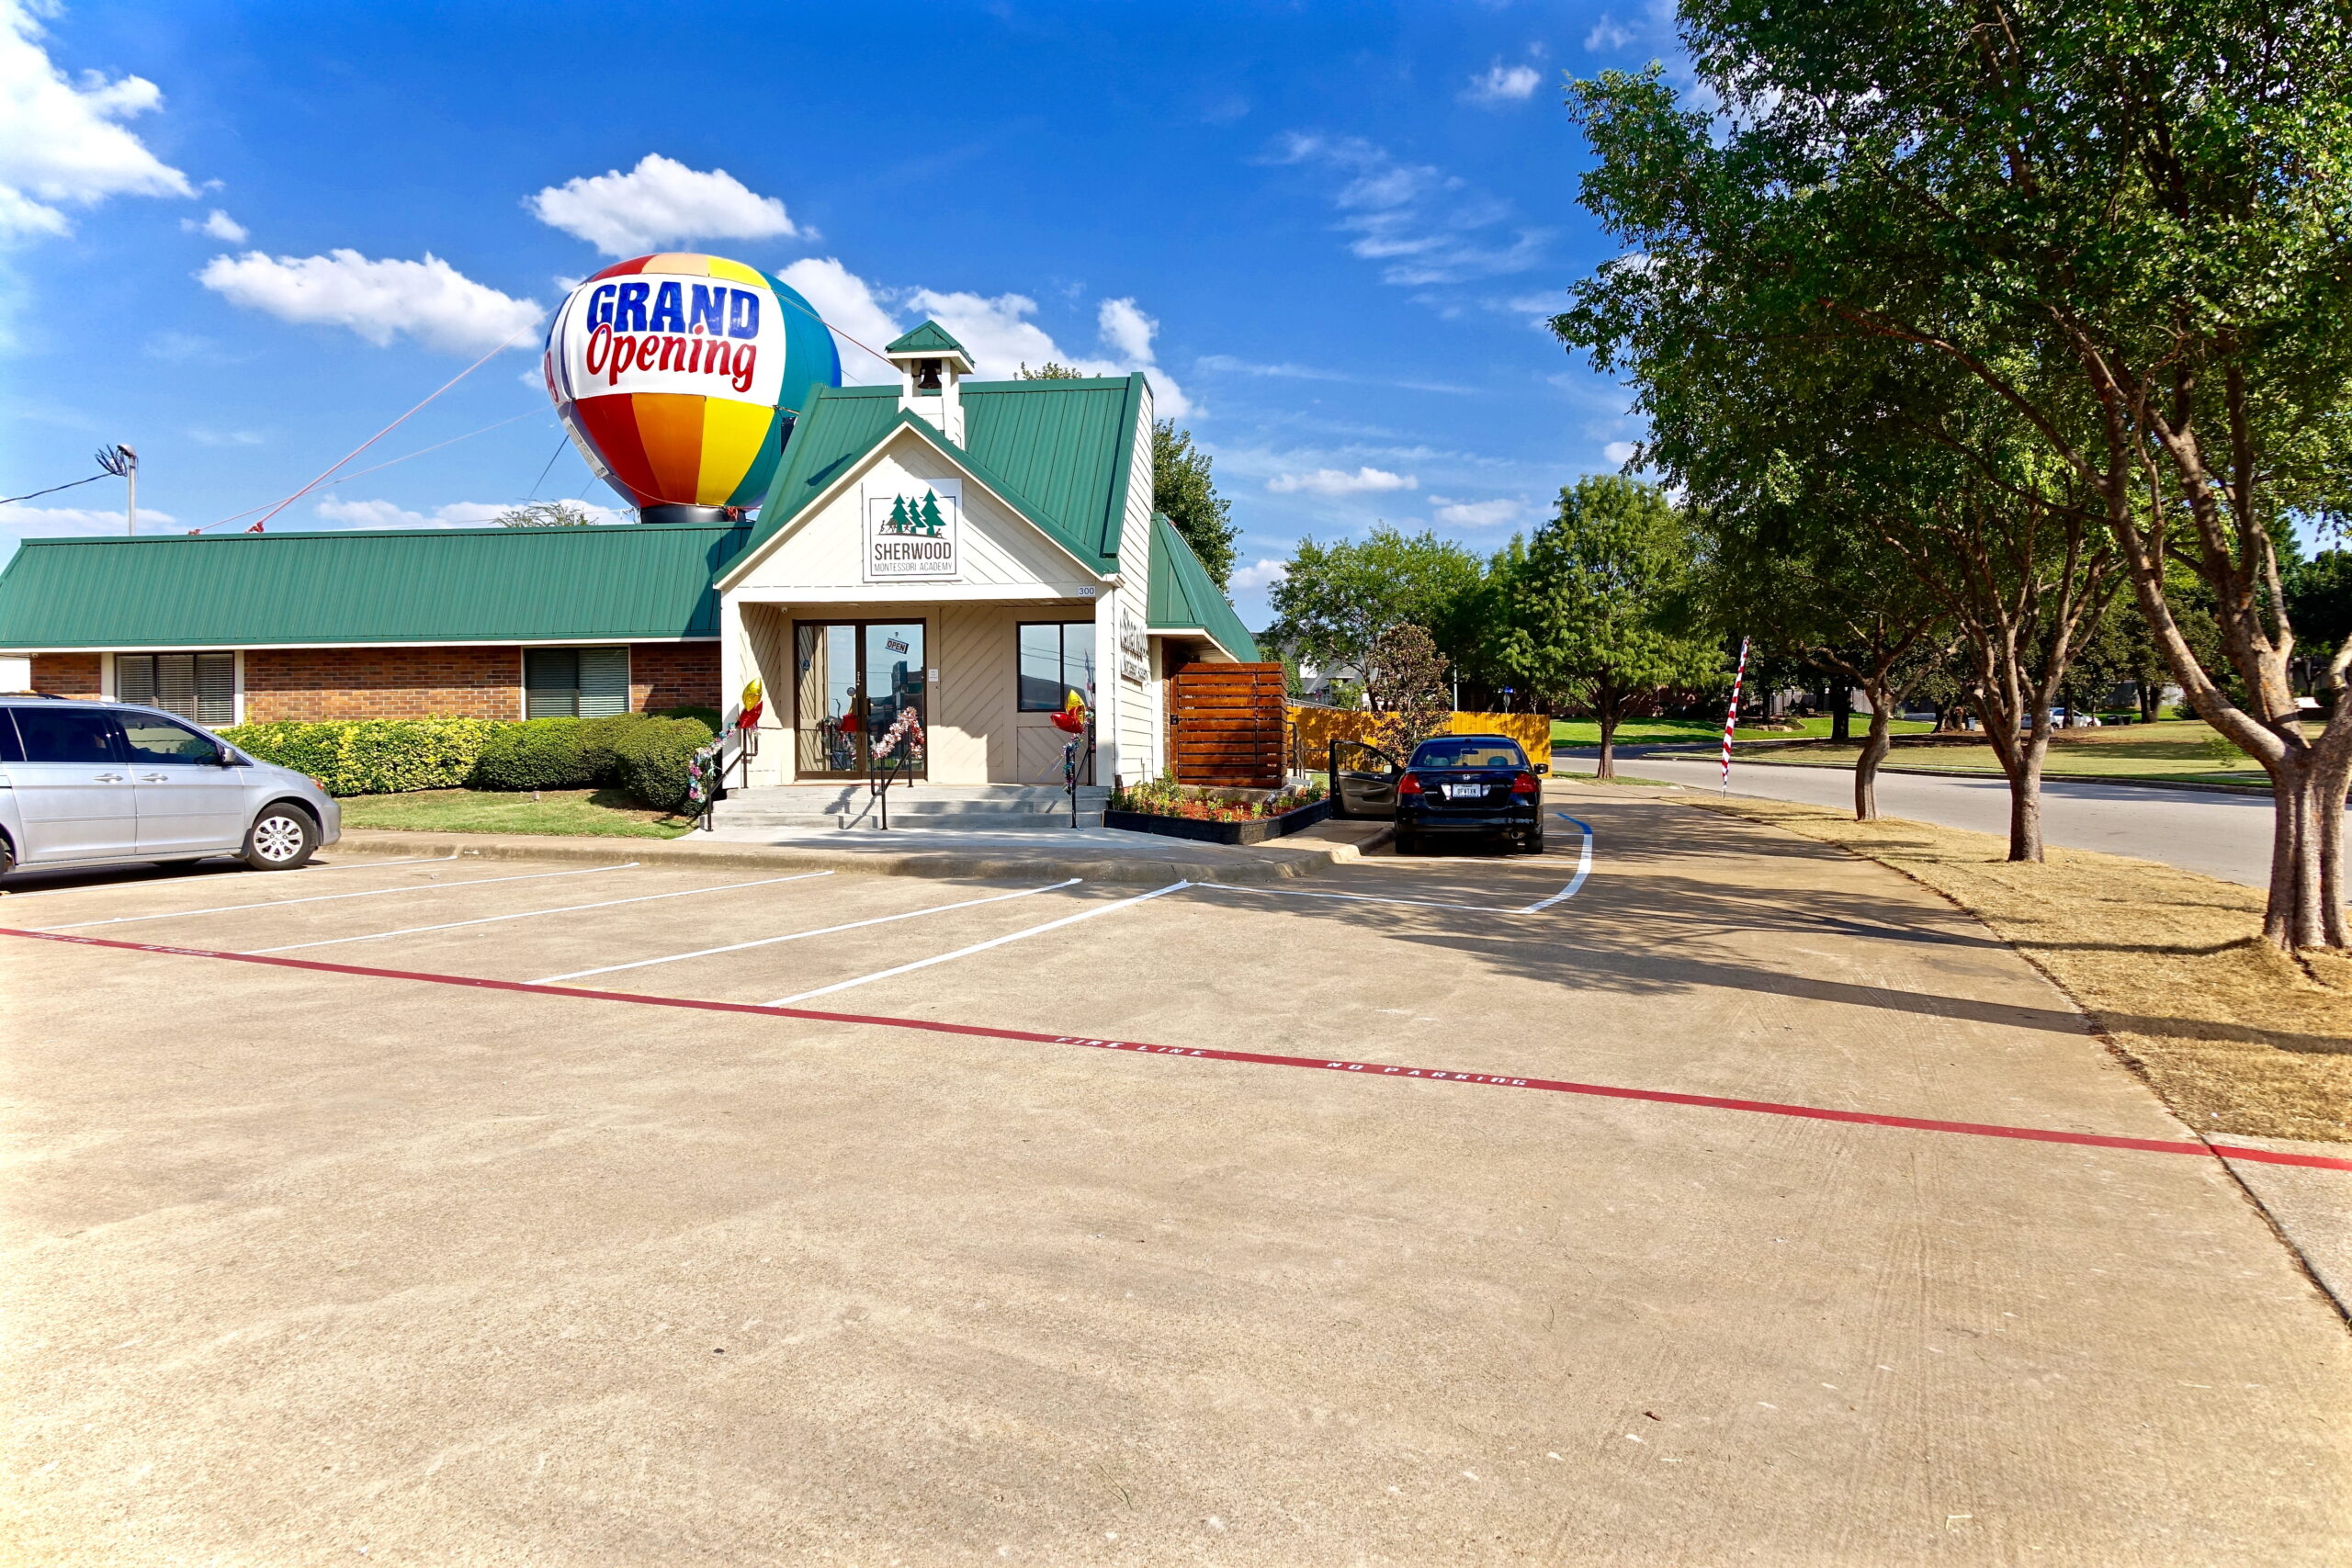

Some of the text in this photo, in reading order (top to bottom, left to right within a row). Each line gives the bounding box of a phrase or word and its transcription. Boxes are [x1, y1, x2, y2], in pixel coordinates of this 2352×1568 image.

[586, 281, 760, 340] GRAND
[586, 323, 757, 393] Opening
[875, 542, 952, 560] SHERWOOD
[874, 561, 953, 572] MONTESSORI ACADEMY
[1078, 587, 1095, 595] 300
[887, 639, 906, 653] OPEN
[1055, 1037, 1125, 1048] FIRE
[1327, 1062, 1528, 1086] NO PARKING
